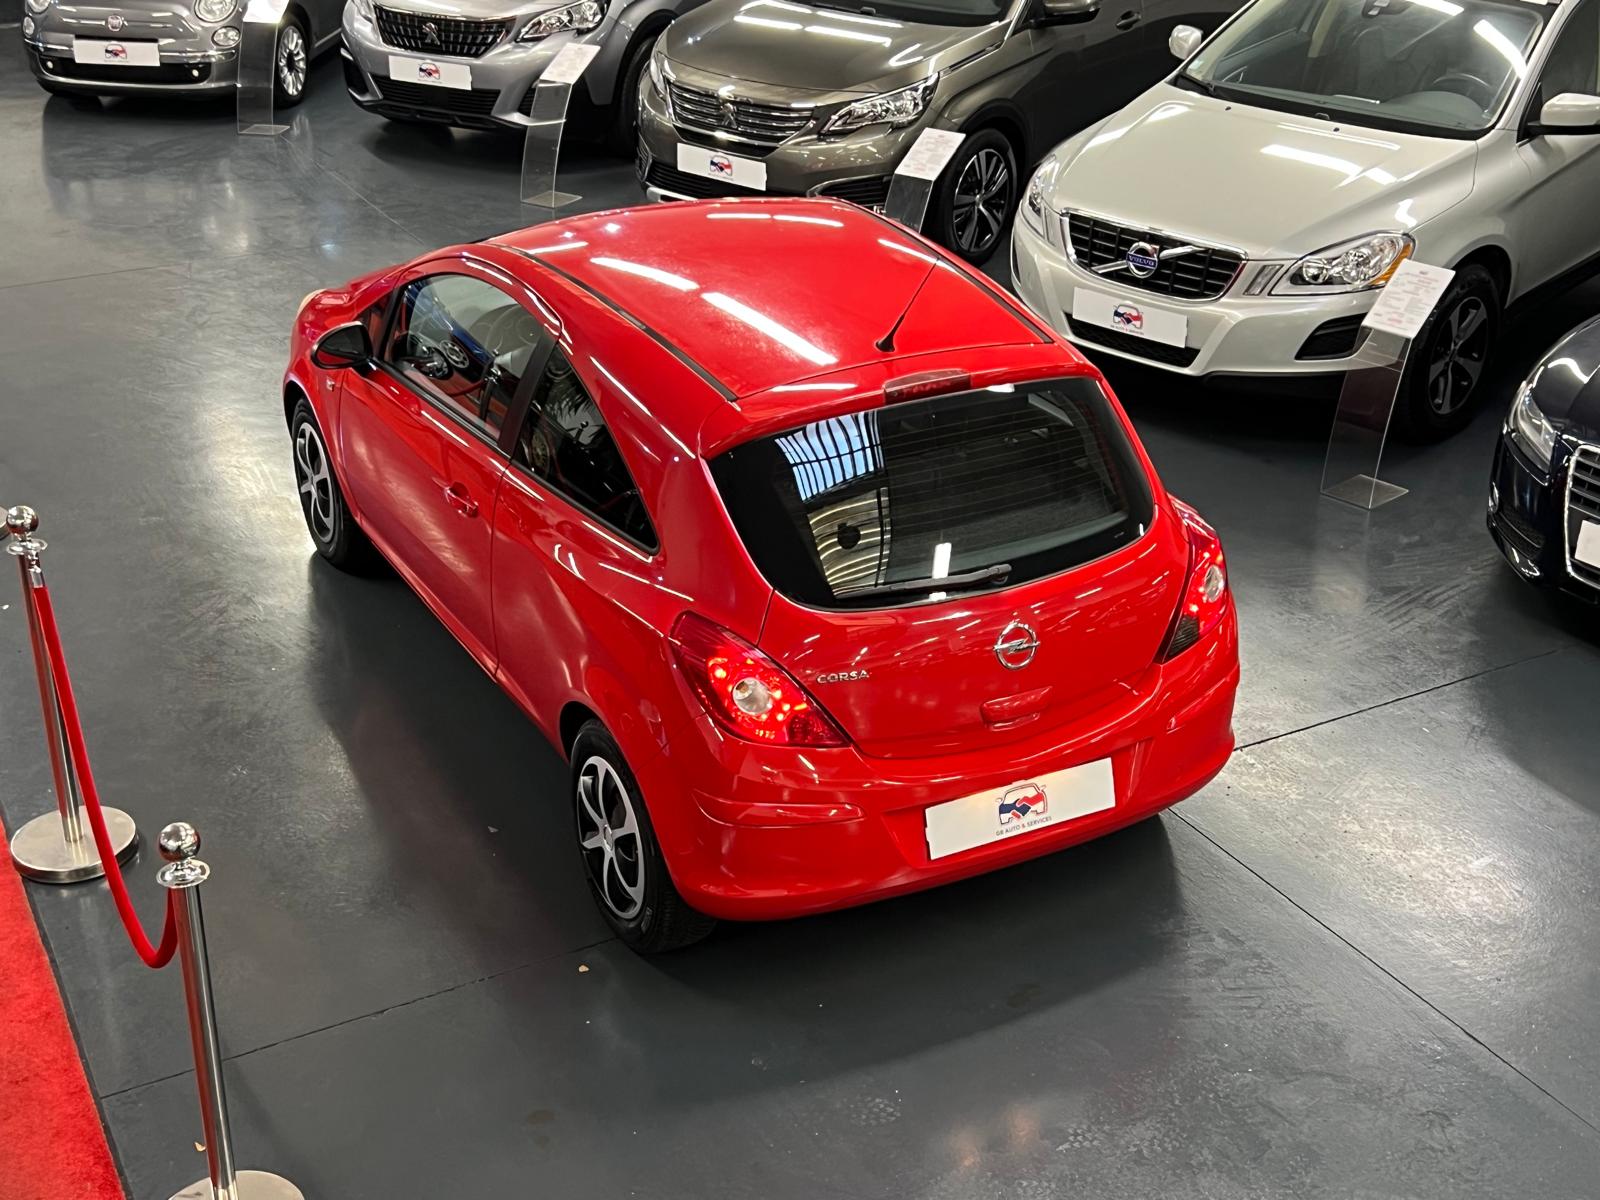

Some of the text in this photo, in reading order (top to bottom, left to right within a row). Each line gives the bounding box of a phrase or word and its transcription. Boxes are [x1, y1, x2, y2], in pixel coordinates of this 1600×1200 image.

[1128, 254, 1155, 266] VOLVO
[817, 670, 870, 684] CORSA
[1005, 824, 1020, 833] AUTO
[1027, 816, 1052, 827] SERVICES
